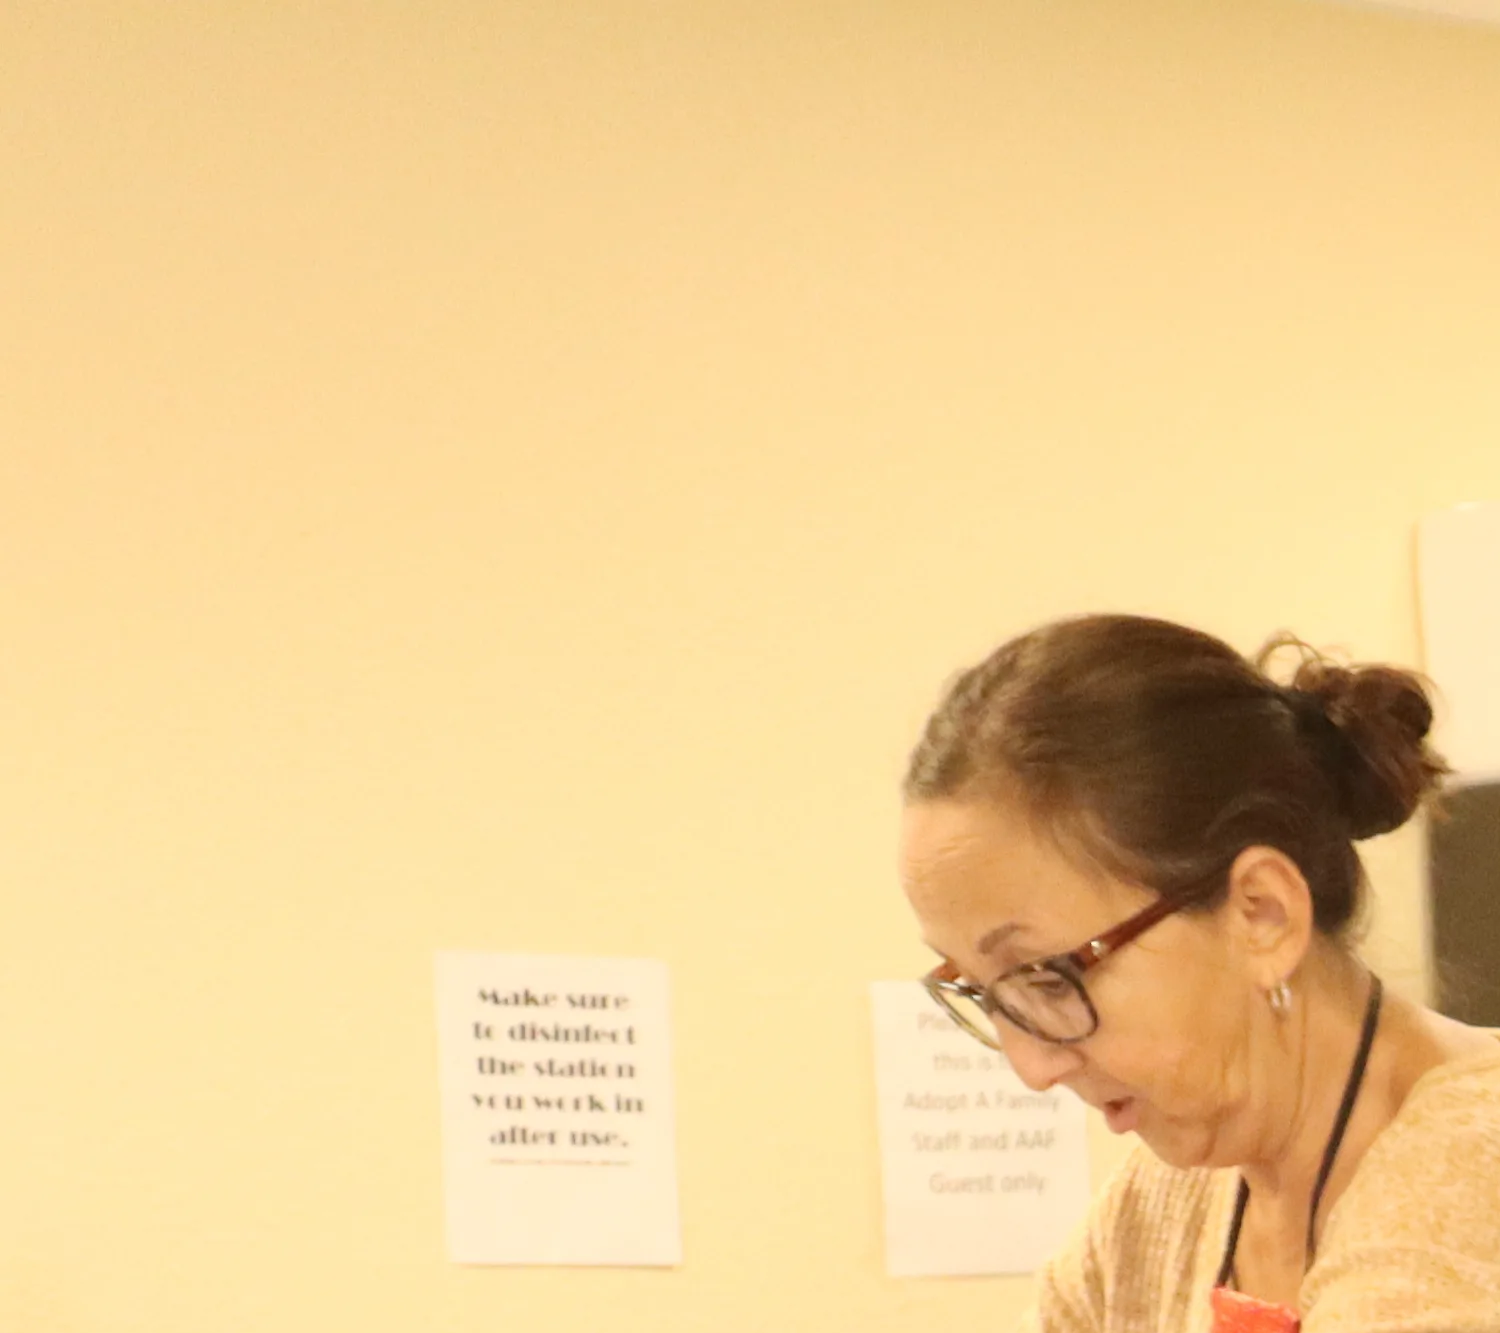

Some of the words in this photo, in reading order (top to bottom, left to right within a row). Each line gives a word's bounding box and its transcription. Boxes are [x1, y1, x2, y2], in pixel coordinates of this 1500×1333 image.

[477, 986, 559, 1008] Make
[564, 992, 632, 1011] sure
[472, 1021, 495, 1042] to
[506, 1021, 637, 1045] disinfect
[477, 1056, 525, 1077] the
[532, 1057, 637, 1080] station
[469, 1092, 526, 1114] you
[530, 1093, 609, 1114] work
[613, 1093, 645, 1115] in
[902, 1092, 968, 1114] Adopt
[974, 1091, 991, 1110] A
[994, 1090, 1061, 1114] Family
[487, 1124, 559, 1147] after
[568, 1129, 630, 1149] use.
[910, 1131, 962, 1152] Staff
[967, 1131, 1010, 1152] and
[928, 1170, 995, 1194] Guest
[1000, 1171, 1050, 1197] only
